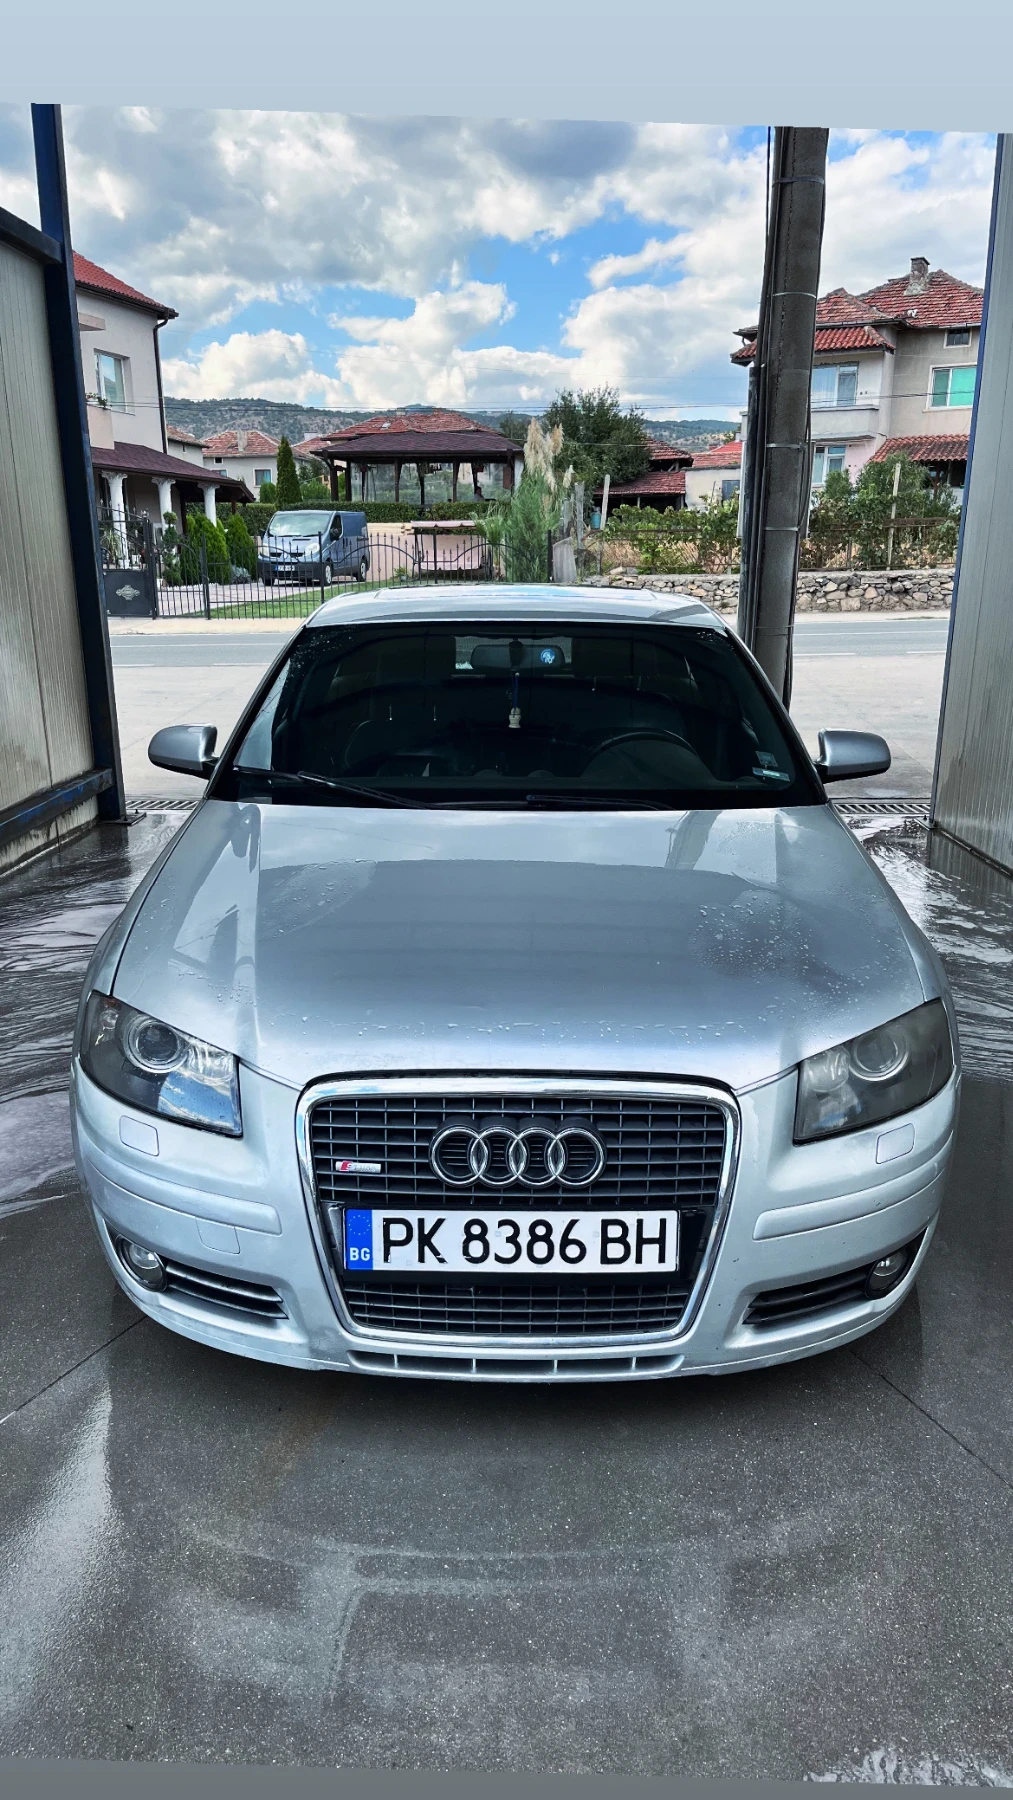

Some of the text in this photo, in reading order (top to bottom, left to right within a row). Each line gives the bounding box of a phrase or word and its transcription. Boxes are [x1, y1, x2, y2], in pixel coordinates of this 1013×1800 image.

[349, 1247, 371, 1262] BG
[383, 1217, 667, 1264] PK 8386 BH
